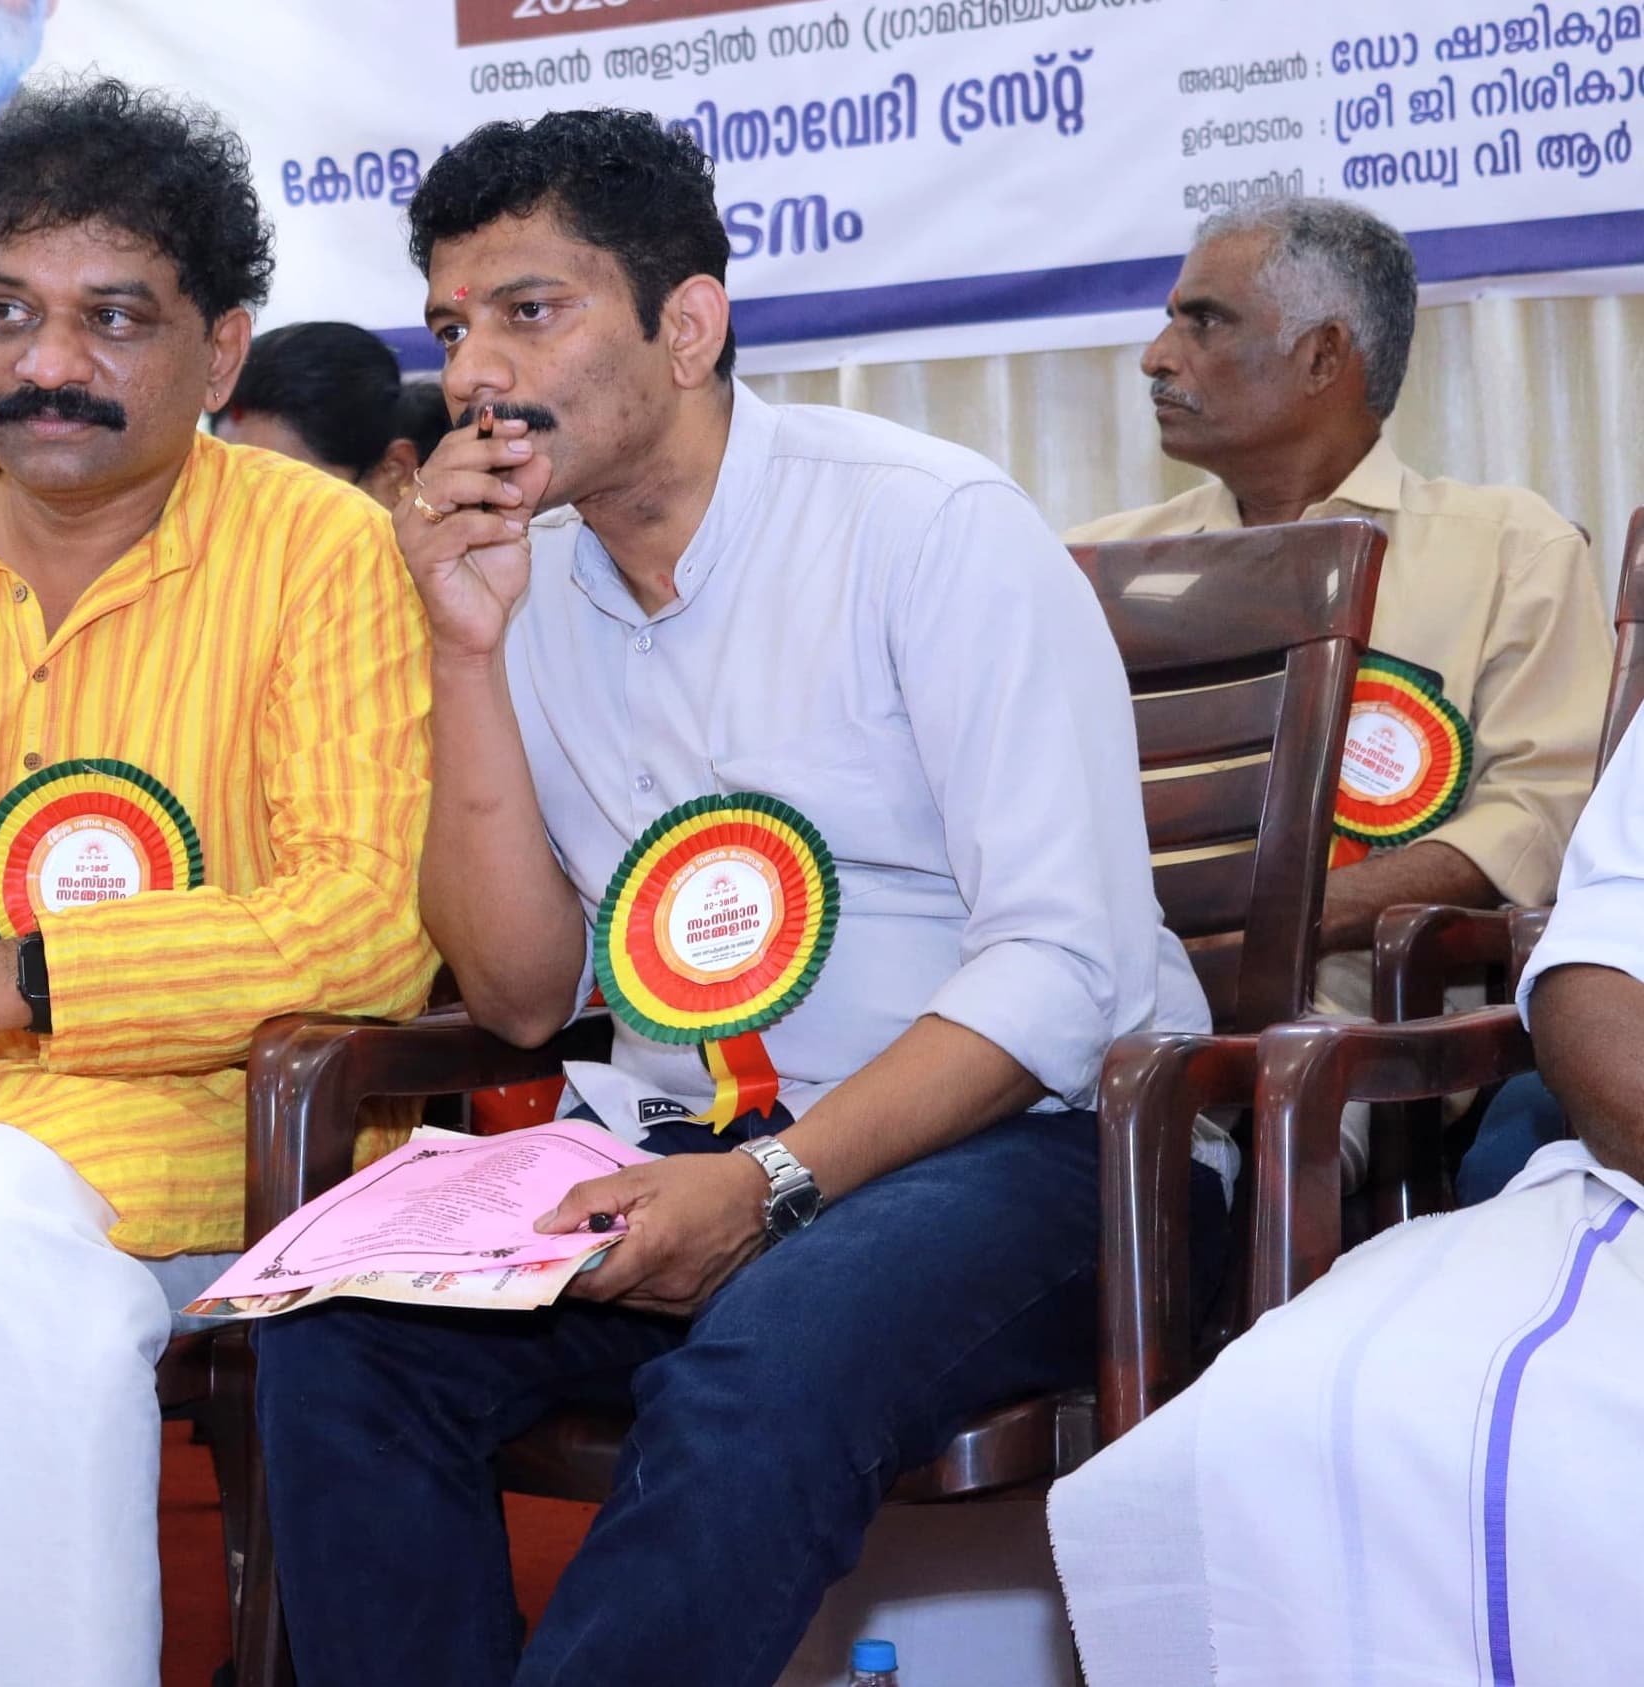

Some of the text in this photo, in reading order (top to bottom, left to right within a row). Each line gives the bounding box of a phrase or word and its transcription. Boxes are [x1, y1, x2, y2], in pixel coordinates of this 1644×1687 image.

[469, 48, 591, 94] ശങ്കരൻ
[768, 12, 849, 58] നഗർ
[1331, 32, 1419, 74] ഡോ
[1434, 3, 1644, 62] ഷാജികുമ
[1182, 116, 1303, 157] ഉദ്ഘാടനം
[1335, 82, 1394, 144] ശ്രീ
[1408, 75, 1456, 125] ജി
[1471, 61, 1644, 117] നിശീകാ
[282, 148, 421, 206] കേരള
[1342, 146, 1458, 190] അഡ്വ
[1474, 128, 1521, 178] വി
[1536, 119, 1632, 178] ആർ
